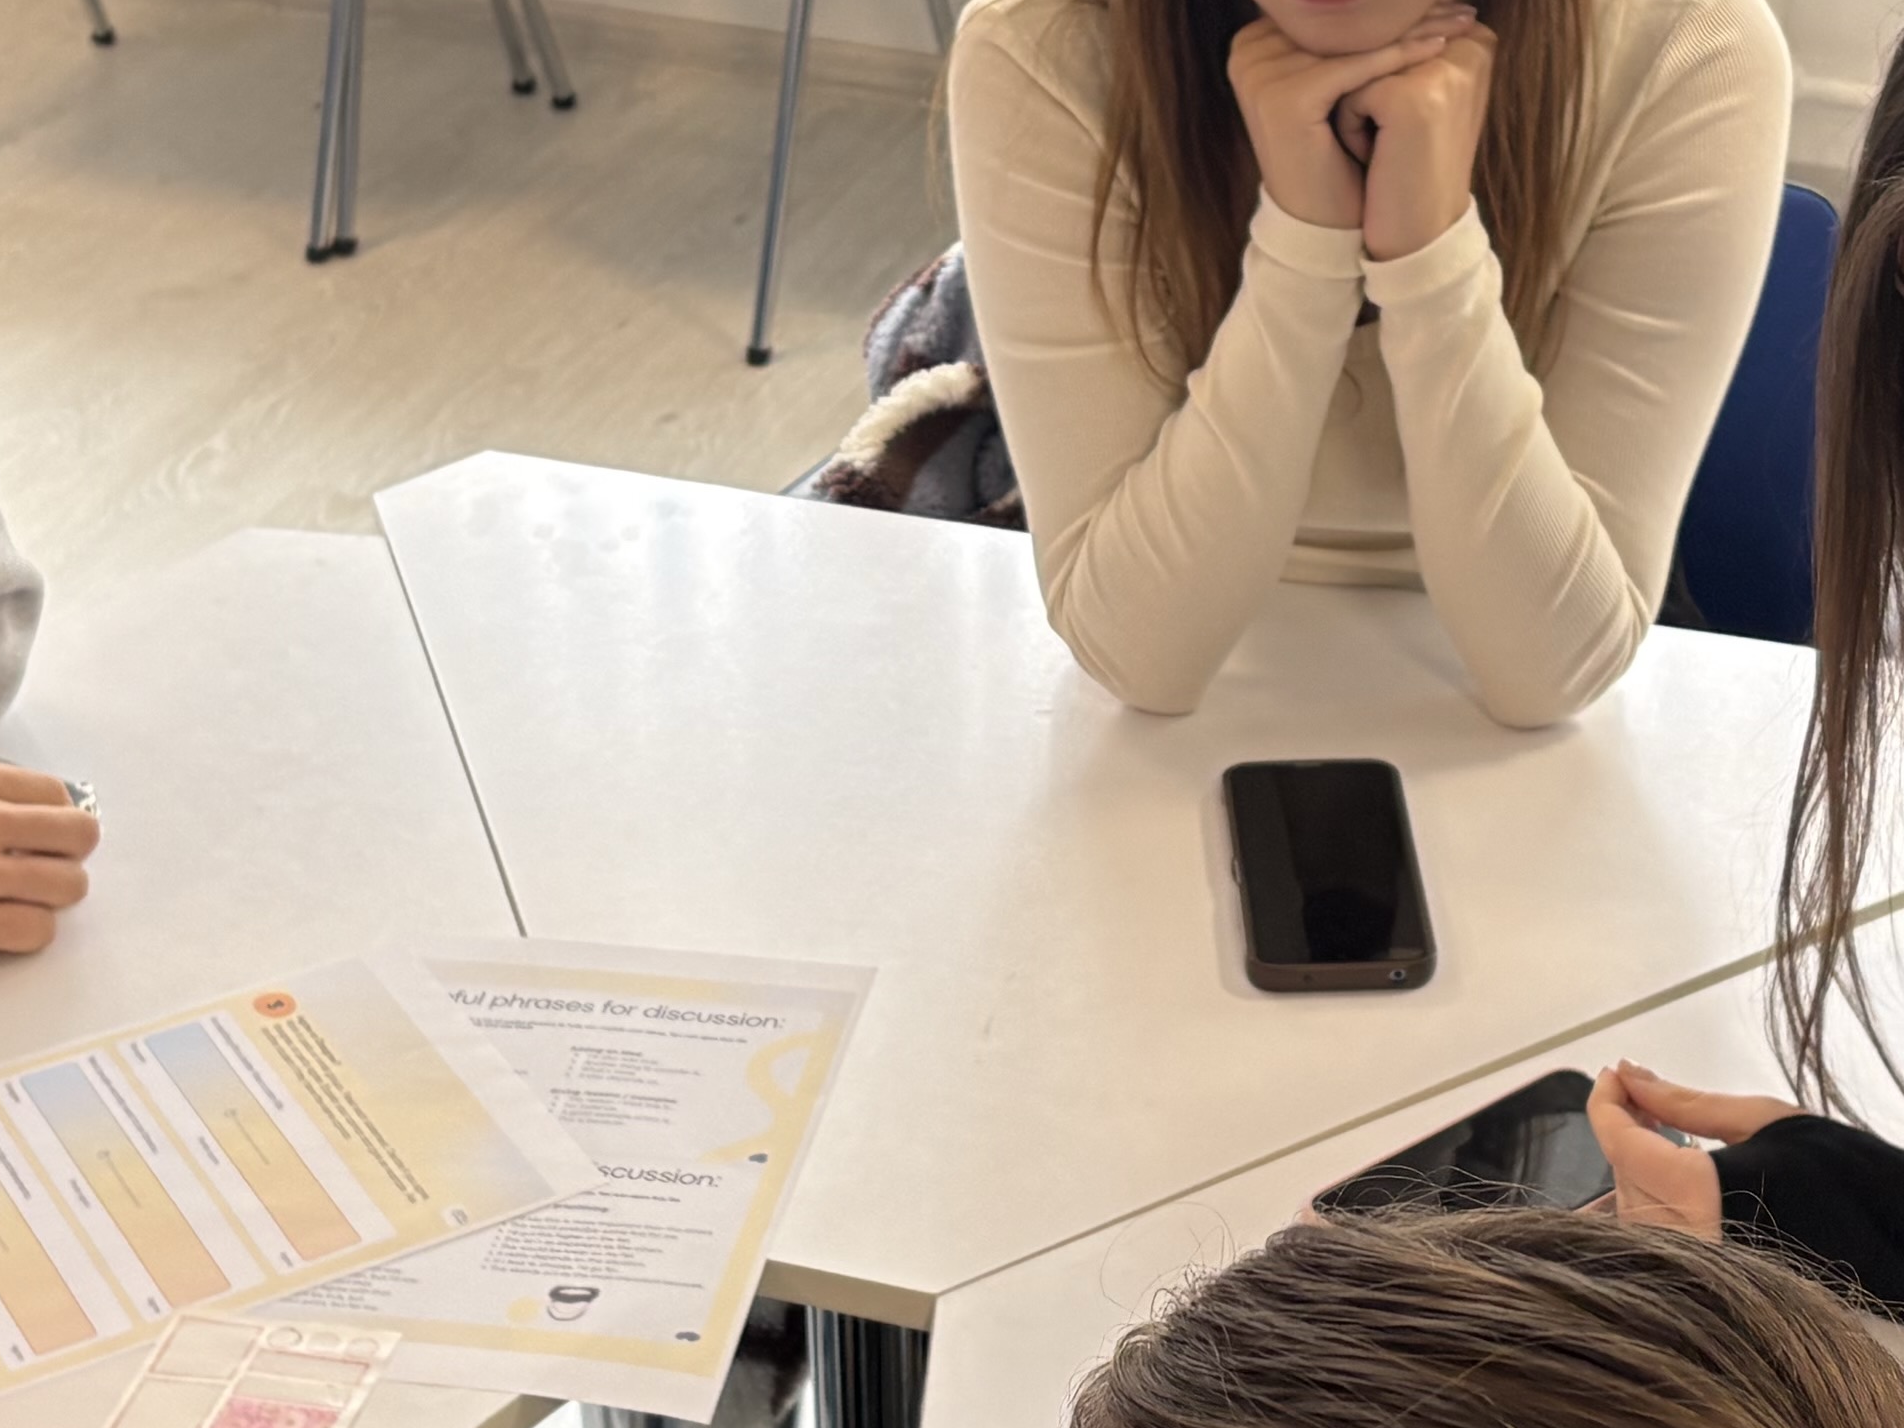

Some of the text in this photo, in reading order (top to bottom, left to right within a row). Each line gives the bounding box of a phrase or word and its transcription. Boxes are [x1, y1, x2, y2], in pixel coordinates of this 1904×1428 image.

[489, 993, 595, 1013] phrases
[601, 999, 639, 1016] for
[643, 1005, 787, 1029] discussion:
